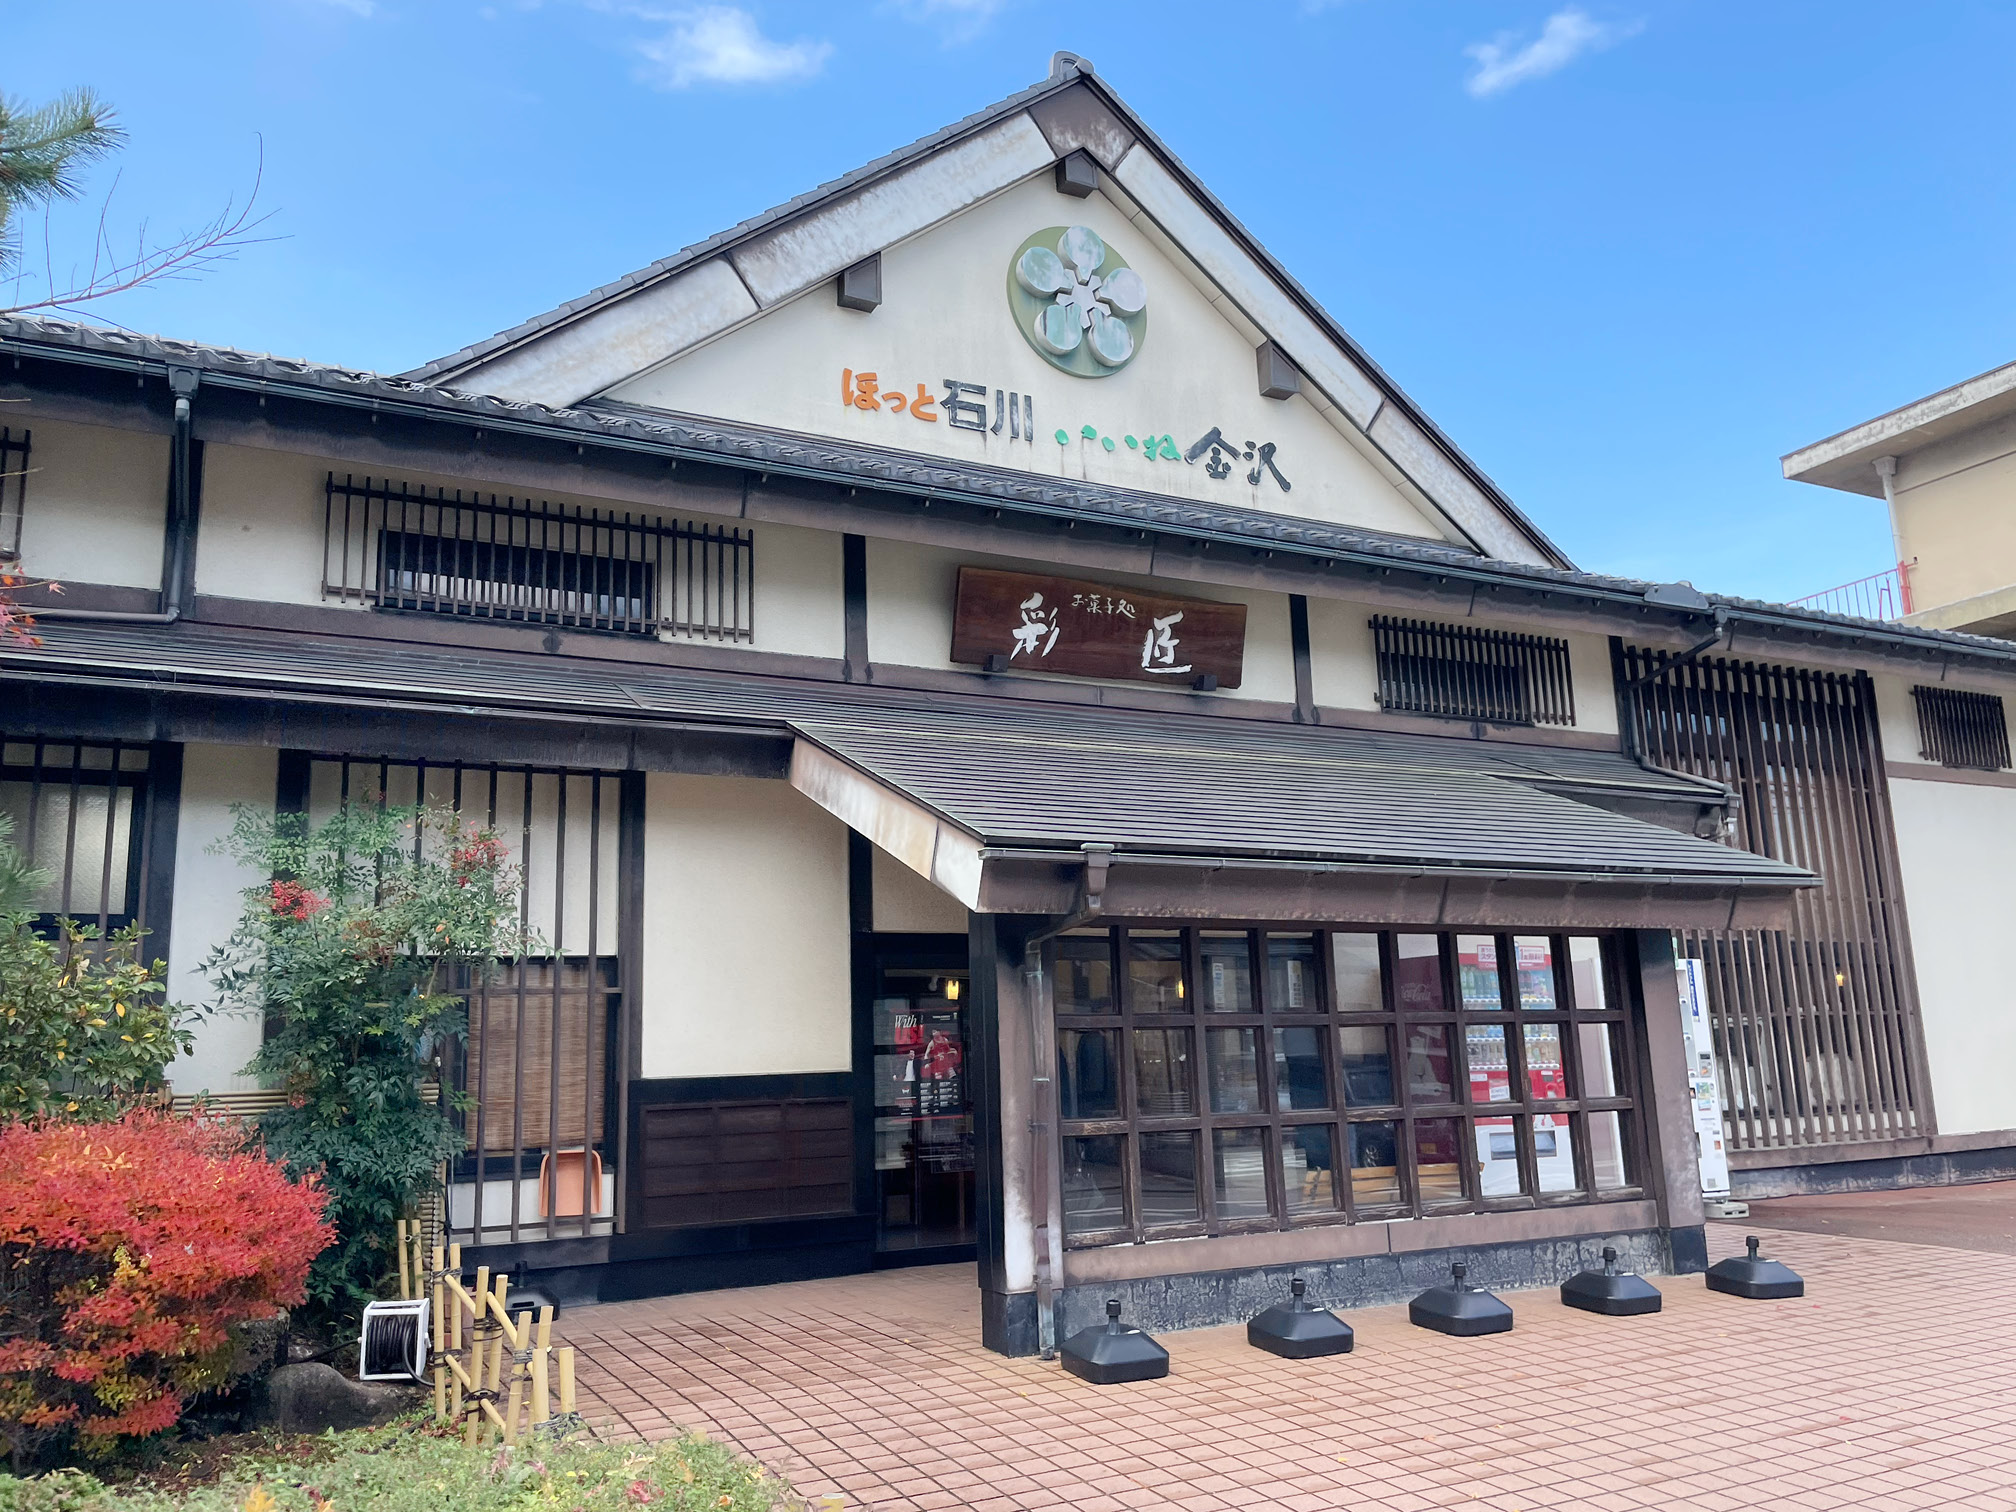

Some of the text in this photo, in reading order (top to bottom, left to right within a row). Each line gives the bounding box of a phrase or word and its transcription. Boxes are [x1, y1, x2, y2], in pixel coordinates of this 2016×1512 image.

[1071, 593, 1137, 620] お菓子処
[894, 1014, 917, 1028] With
